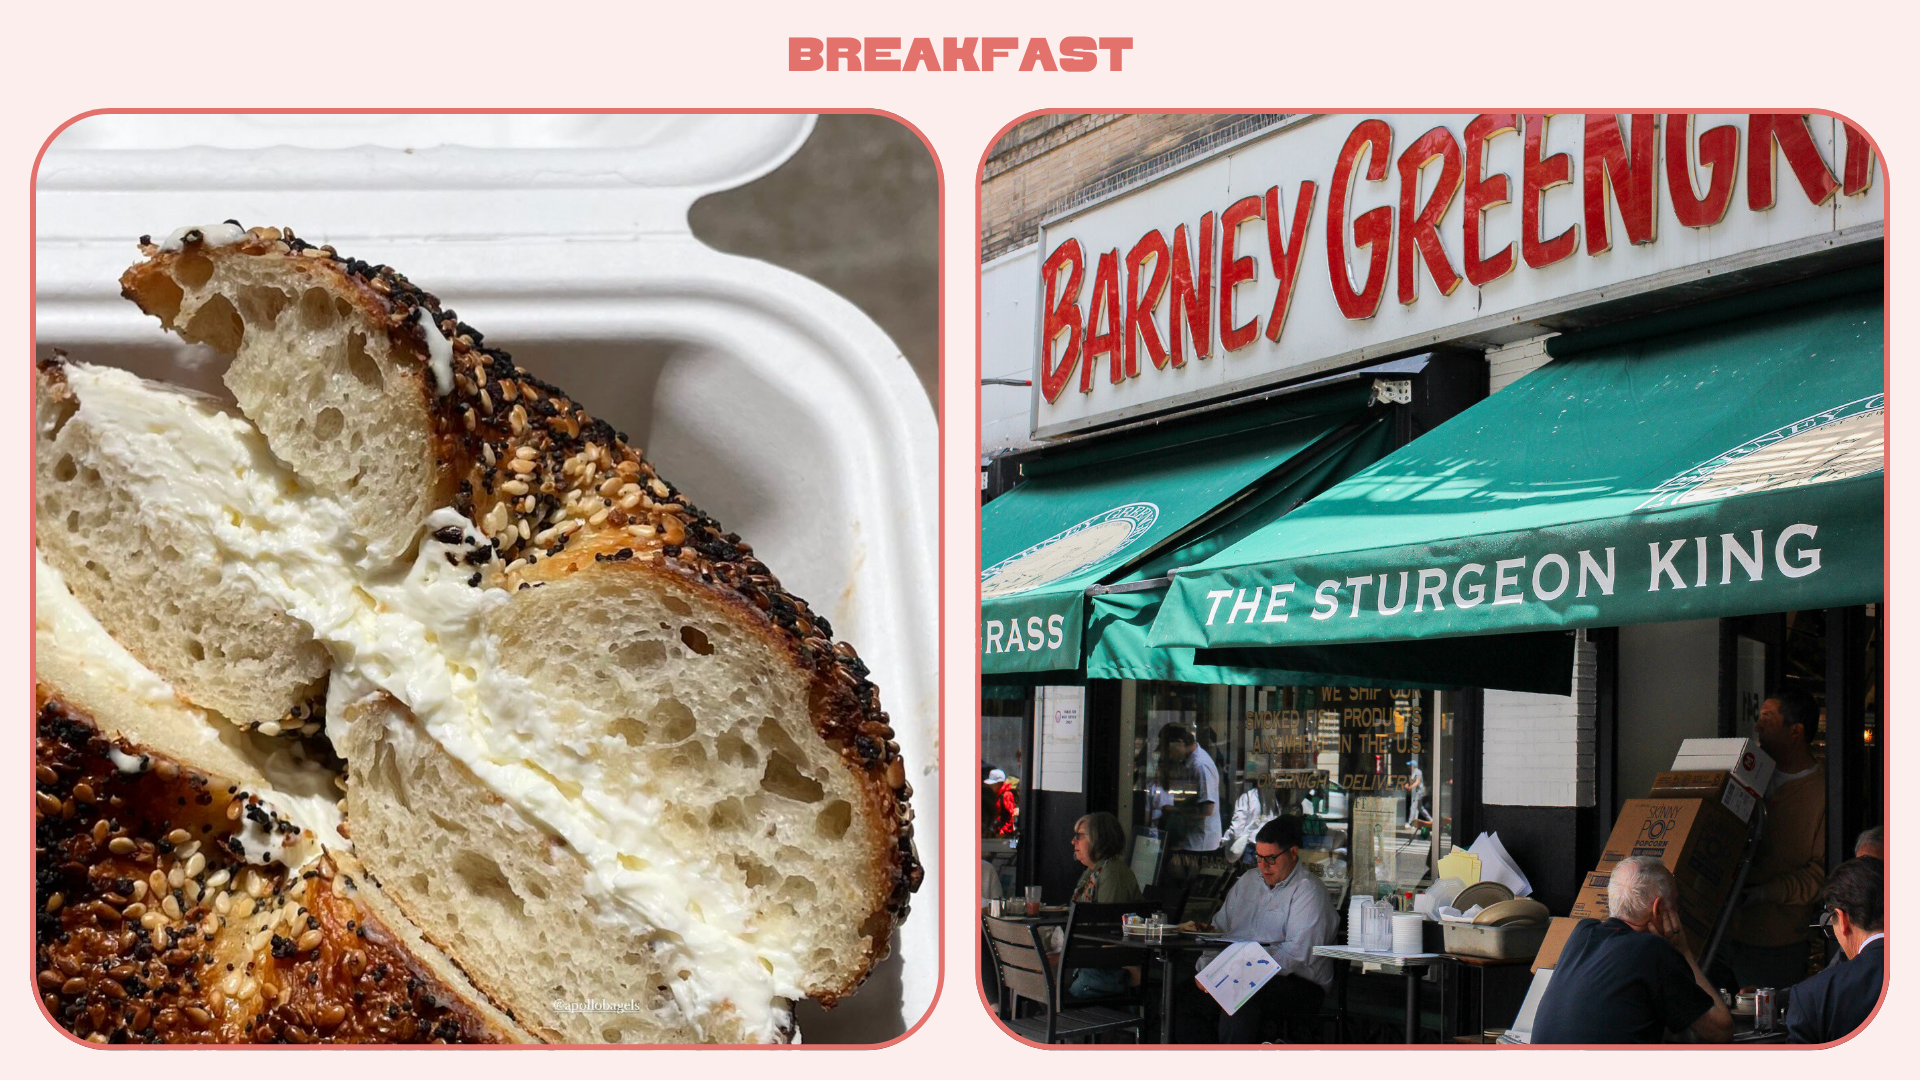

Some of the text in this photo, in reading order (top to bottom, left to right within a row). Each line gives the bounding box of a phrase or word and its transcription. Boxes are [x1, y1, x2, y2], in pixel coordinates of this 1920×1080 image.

[1041, 180, 1318, 405] BARNEY
[1205, 523, 1822, 626] THE STURGEON KING
[981, 614, 1065, 654] RASS
[1321, 686, 1343, 702] WE
[1349, 687, 1382, 701] SHIP
[1245, 706, 1423, 730] SMOKED FISH PRODUCTS
[1252, 734, 1425, 754] ANYWHERE IN THE U.S.
[1647, 803, 1683, 819] SKINNY
[1638, 819, 1676, 840] POP
[1634, 840, 1669, 848] POPCORN
